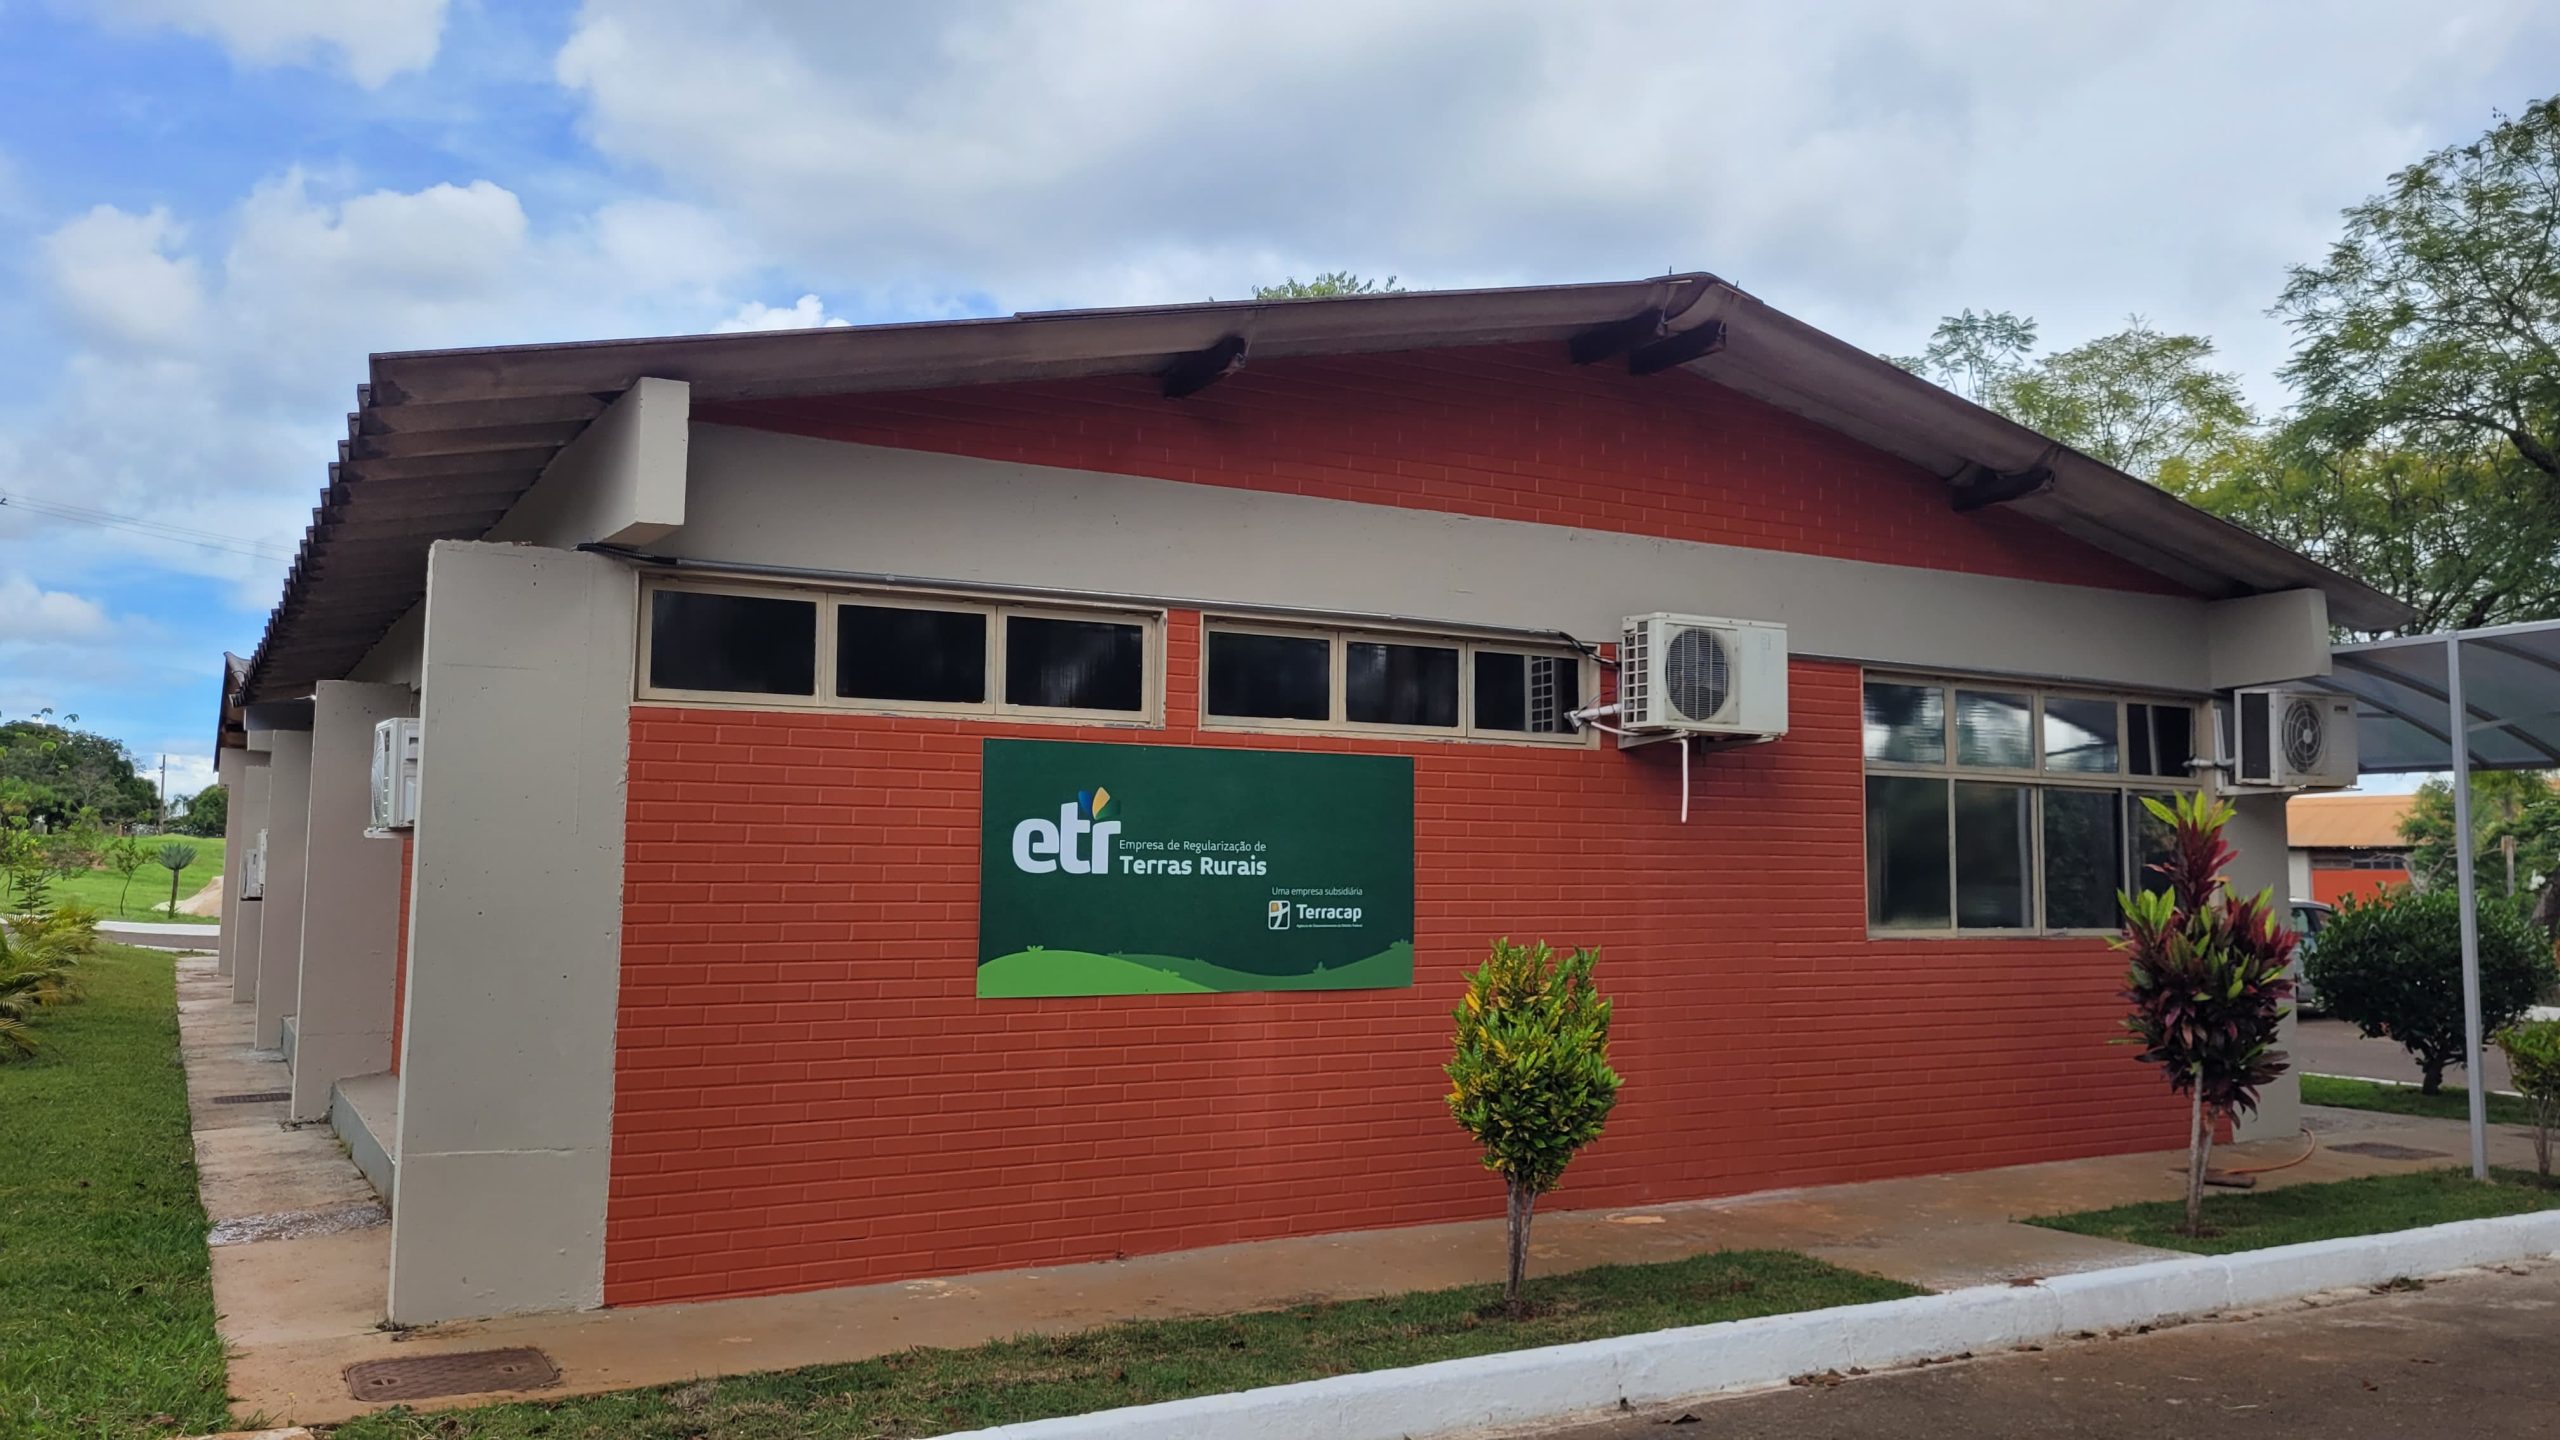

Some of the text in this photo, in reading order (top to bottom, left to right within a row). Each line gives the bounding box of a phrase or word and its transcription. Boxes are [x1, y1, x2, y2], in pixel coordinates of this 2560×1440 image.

[1012, 802, 1121, 874] etr
[1119, 839, 1267, 854] Empresa de Regularização de
[1119, 855, 1267, 876] Terras Rurais
[1272, 886, 1363, 897] Uma empresa subsidiária
[1296, 904, 1362, 922] Terracap
